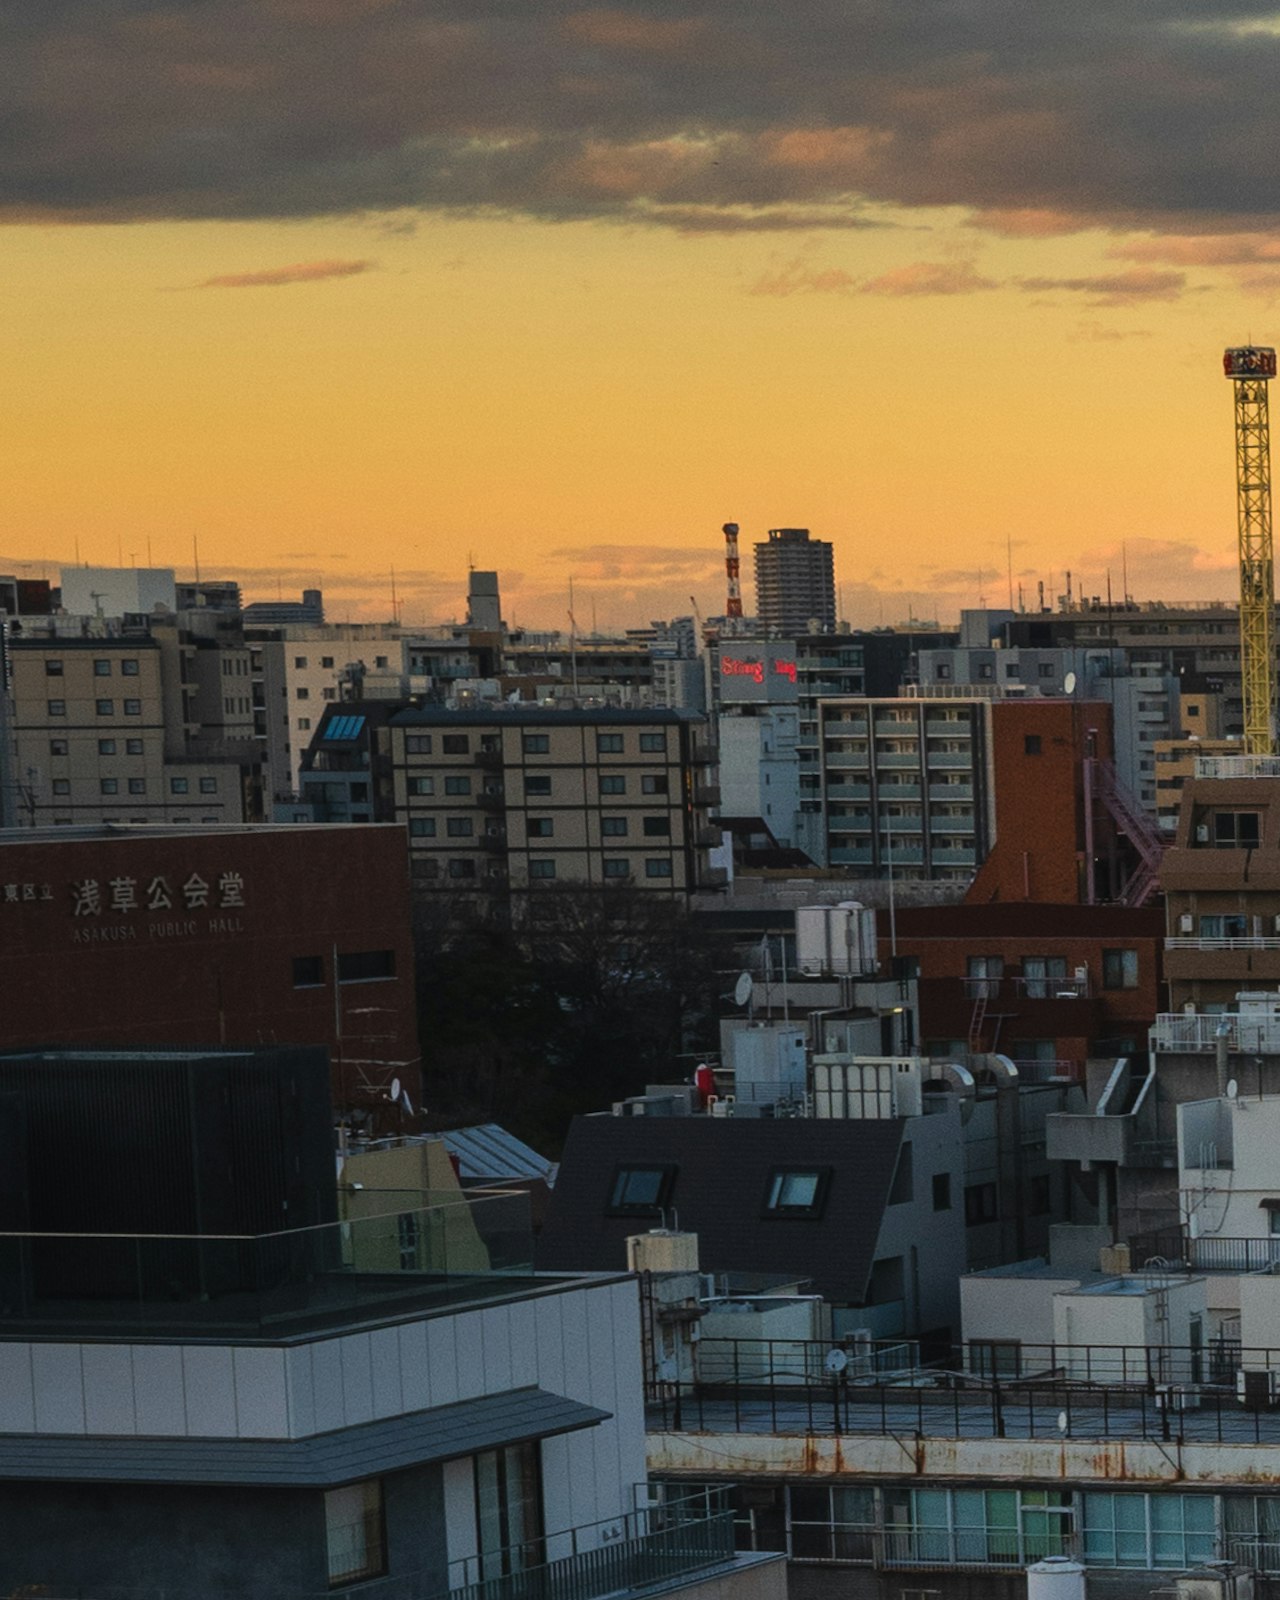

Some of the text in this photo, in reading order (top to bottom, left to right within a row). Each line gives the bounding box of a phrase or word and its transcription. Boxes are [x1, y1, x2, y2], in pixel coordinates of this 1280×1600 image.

[73, 872, 245, 916] 浅草公会堂
[73, 918, 243, 943] ASAKUSA PUBLIC HALL
